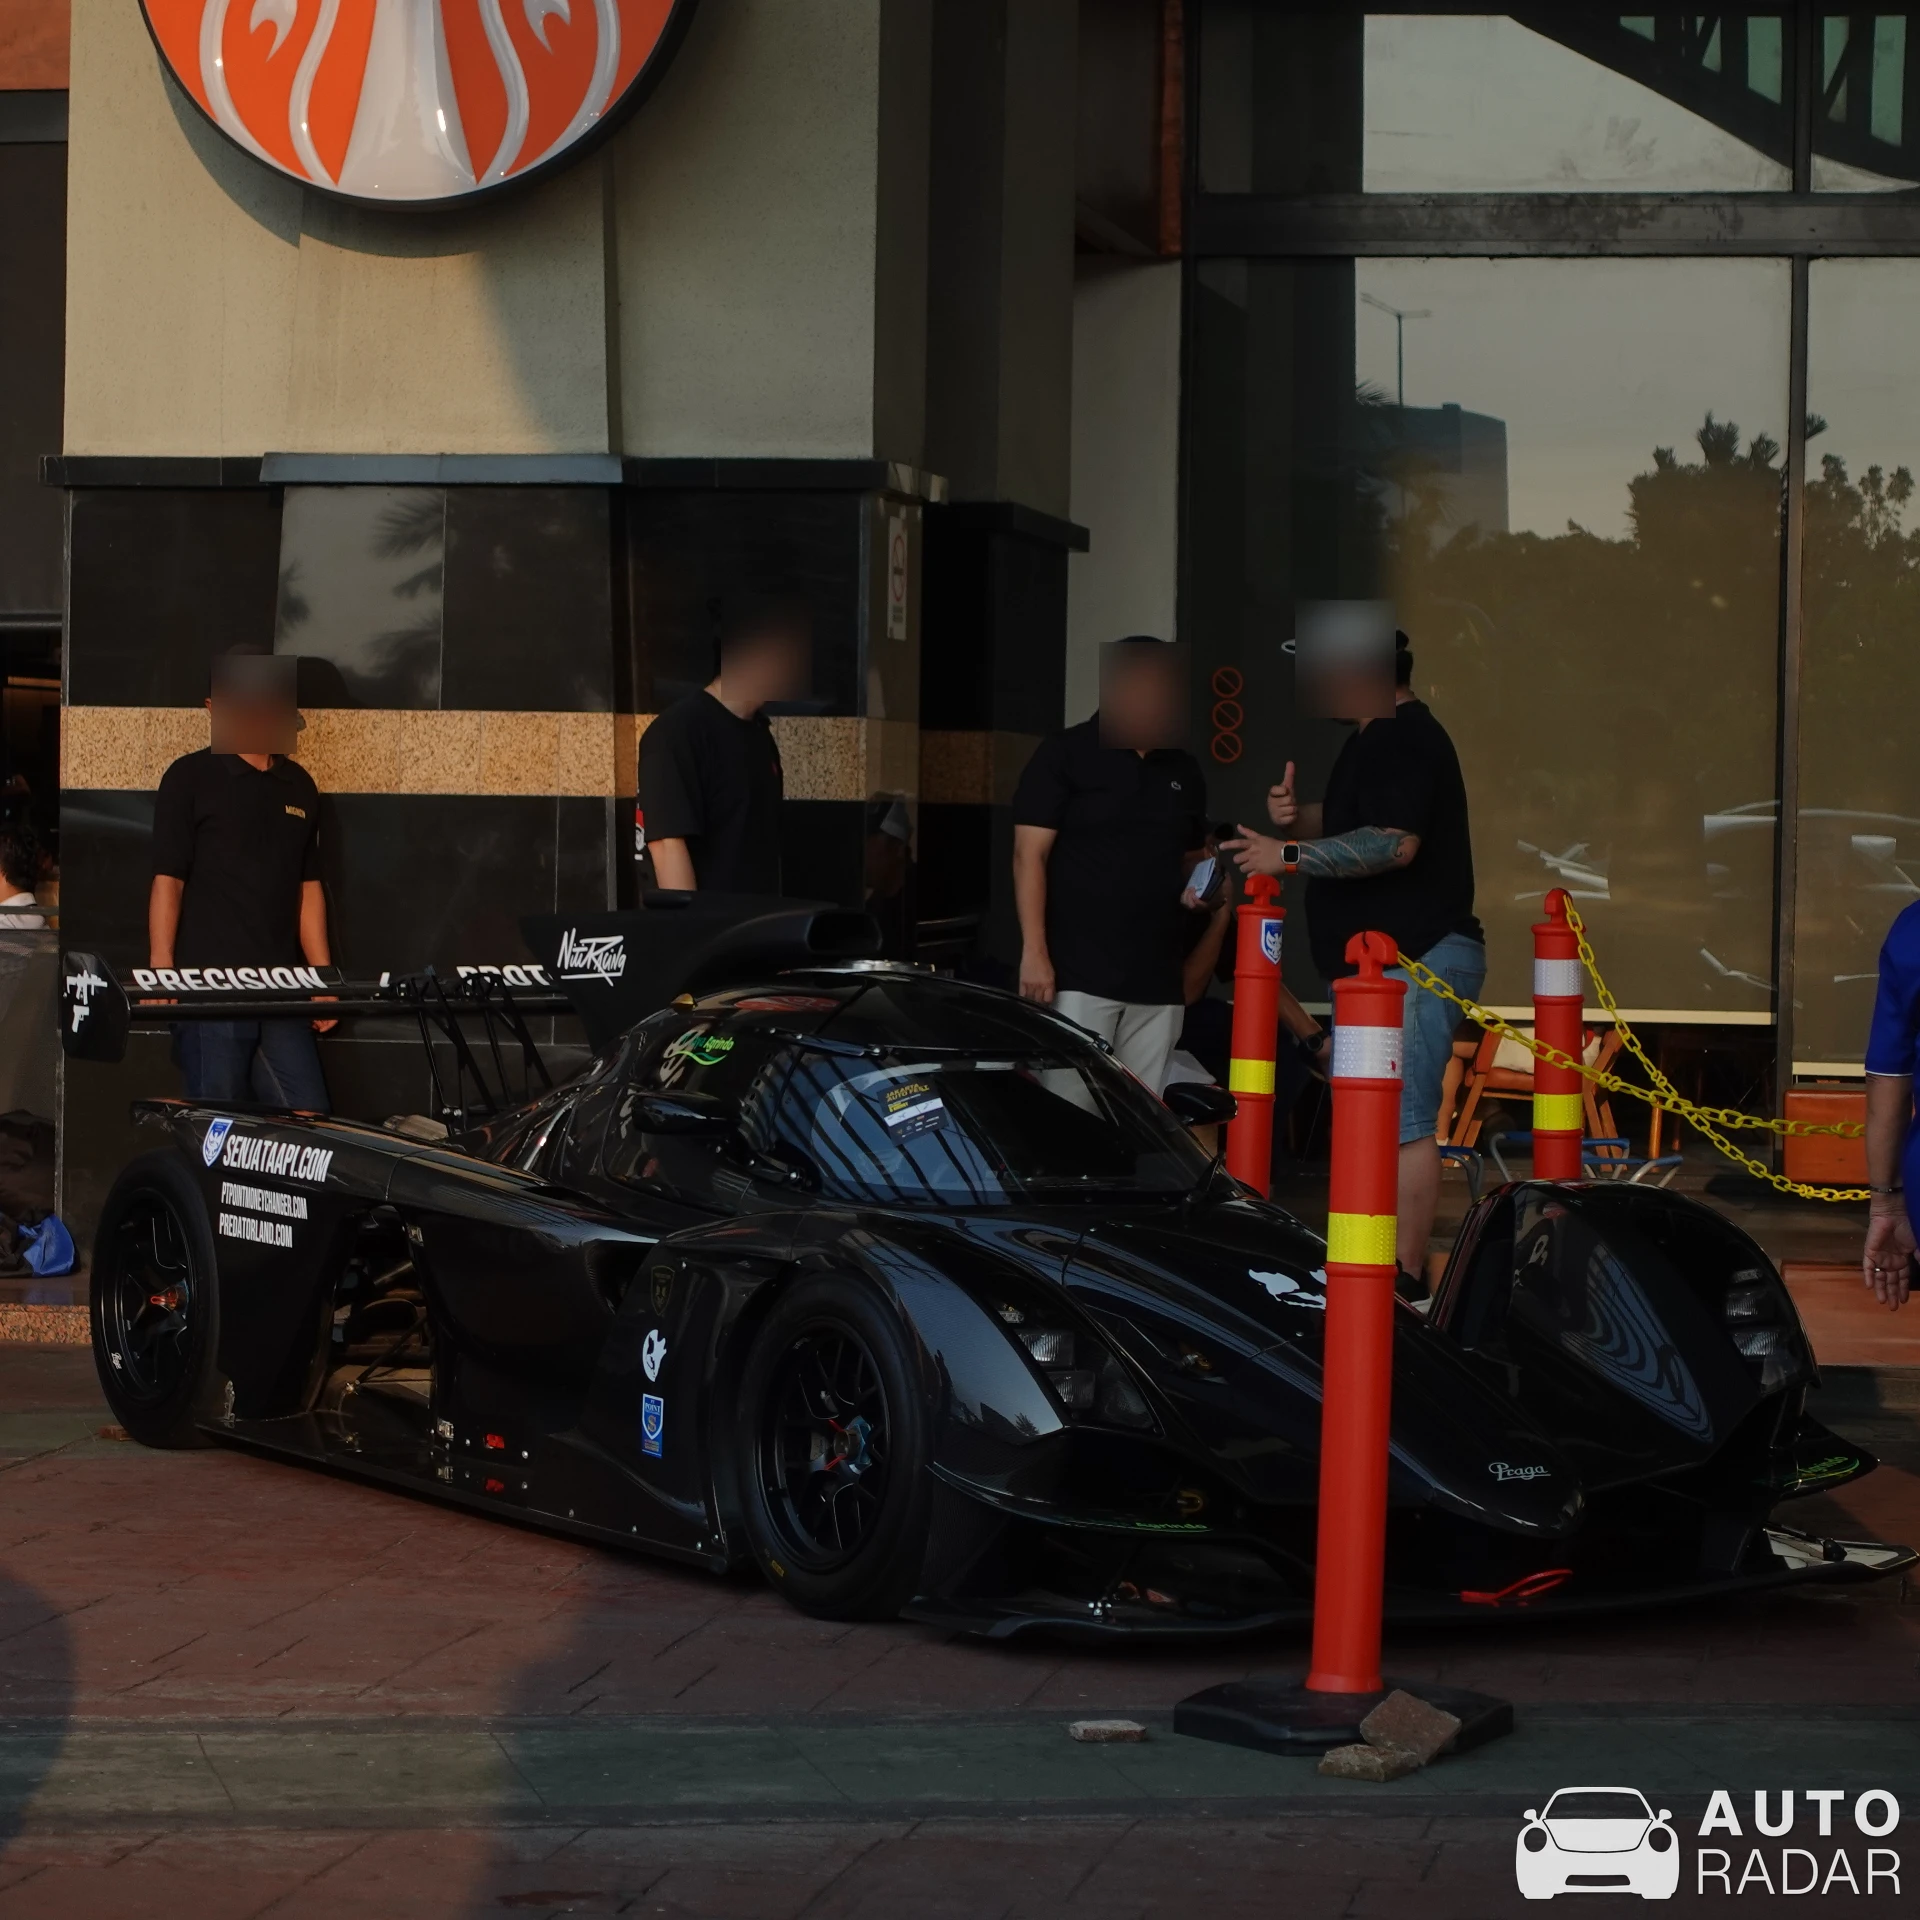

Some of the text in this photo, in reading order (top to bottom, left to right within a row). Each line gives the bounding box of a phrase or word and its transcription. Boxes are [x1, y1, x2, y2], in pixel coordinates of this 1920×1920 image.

[132, 966, 329, 992] PRECISION
[222, 1134, 334, 1183] SENJATAAPI.COM
[220, 1181, 308, 1220] PTPOINTMONEYCHANGER.COM
[218, 1212, 293, 1249] PREDATORLAND.COM
[645, 1402, 661, 1413] POINT
[1488, 1462, 1552, 1481] Praga
